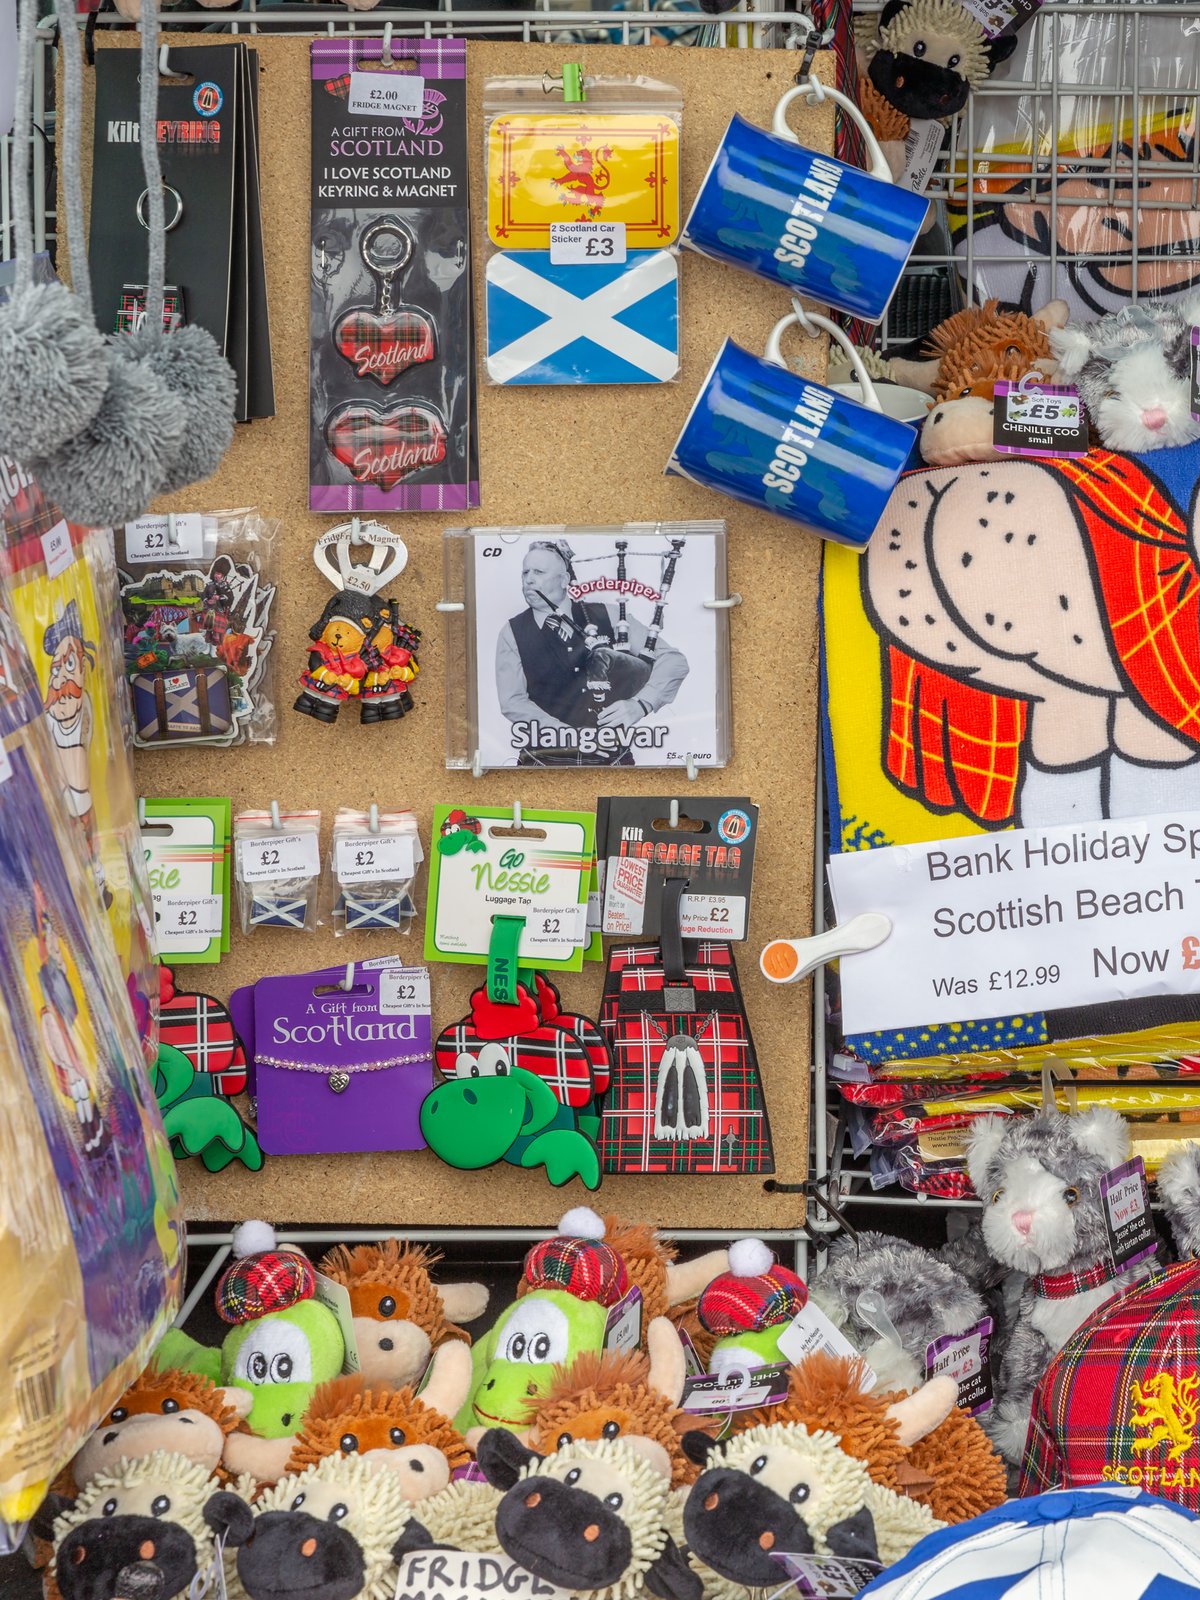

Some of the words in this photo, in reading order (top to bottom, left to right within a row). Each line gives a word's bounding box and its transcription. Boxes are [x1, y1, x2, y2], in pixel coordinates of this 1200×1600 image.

[369, 89, 398, 101] £2.00
[352, 102, 382, 110] FRIDGE
[383, 104, 418, 112] MAGNET
[107, 121, 140, 143] Kilt
[157, 120, 221, 144] EYRING
[331, 127, 340, 137] A
[342, 127, 369, 137] GIFT
[371, 127, 405, 137] FROM
[330, 140, 444, 157] SCOTLAND
[324, 167, 328, 179] I
[331, 167, 370, 179] LOVE
[372, 166, 451, 180] SCOTLAND
[318, 185, 379, 198] KEYRING
[382, 185, 394, 198] &
[396, 184, 458, 198] MAGNET
[773, 156, 844, 270] SCOTLAND
[551, 224, 557, 233] 2
[558, 224, 599, 233] Scotland
[600, 224, 616, 233] Car
[551, 235, 582, 244] Sticker
[585, 237, 614, 257] £3
[354, 333, 431, 375] Scotland
[1029, 404, 1060, 420] £5
[1002, 422, 1052, 435] CHENILLE
[1053, 427, 1080, 437] COO
[762, 383, 835, 495] SCOTLAND
[1028, 436, 1054, 445] small
[352, 436, 440, 482] Scotland
[482, 547, 503, 558] CD
[567, 578, 661, 602] Borderpiper
[510, 719, 669, 753] Slangevar
[621, 826, 644, 841] Kilt
[249, 838, 285, 848] Borderpiper
[285, 836, 302, 846] Gift's
[344, 839, 379, 848] Borderpiper
[260, 849, 280, 866] £2
[355, 850, 375, 867] £2
[499, 848, 525, 870] Go
[620, 841, 702, 868] LUGGAGE
[705, 846, 742, 869] TAG
[926, 843, 1014, 882] Bank
[1023, 827, 1151, 871] Holiday
[620, 857, 647, 876] LOWEST
[470, 861, 551, 895] Nessie
[617, 869, 644, 892] PRICE
[167, 899, 201, 907] Borderpiper
[201, 898, 218, 906] Gift's
[932, 894, 1064, 938] Scottish
[1075, 880, 1185, 920] Beach
[178, 910, 197, 926] £2
[682, 914, 693, 922] My
[710, 907, 730, 922] £2
[542, 918, 560, 934] £2
[606, 922, 615, 931] on
[615, 921, 632, 933] Price!
[697, 925, 733, 934] Reduction
[932, 974, 979, 998] Was
[988, 964, 1061, 993] £12.99
[1093, 944, 1170, 979] Now
[396, 985, 416, 1000] £2
[305, 1003, 316, 1014] A
[320, 1002, 348, 1015] Gift
[352, 1002, 378, 1013] from
[272, 1014, 418, 1046] Scotland
[1109, 1188, 1123, 1206] Half
[1123, 1182, 1139, 1198] Price
[967, 1385, 988, 1401] collar
